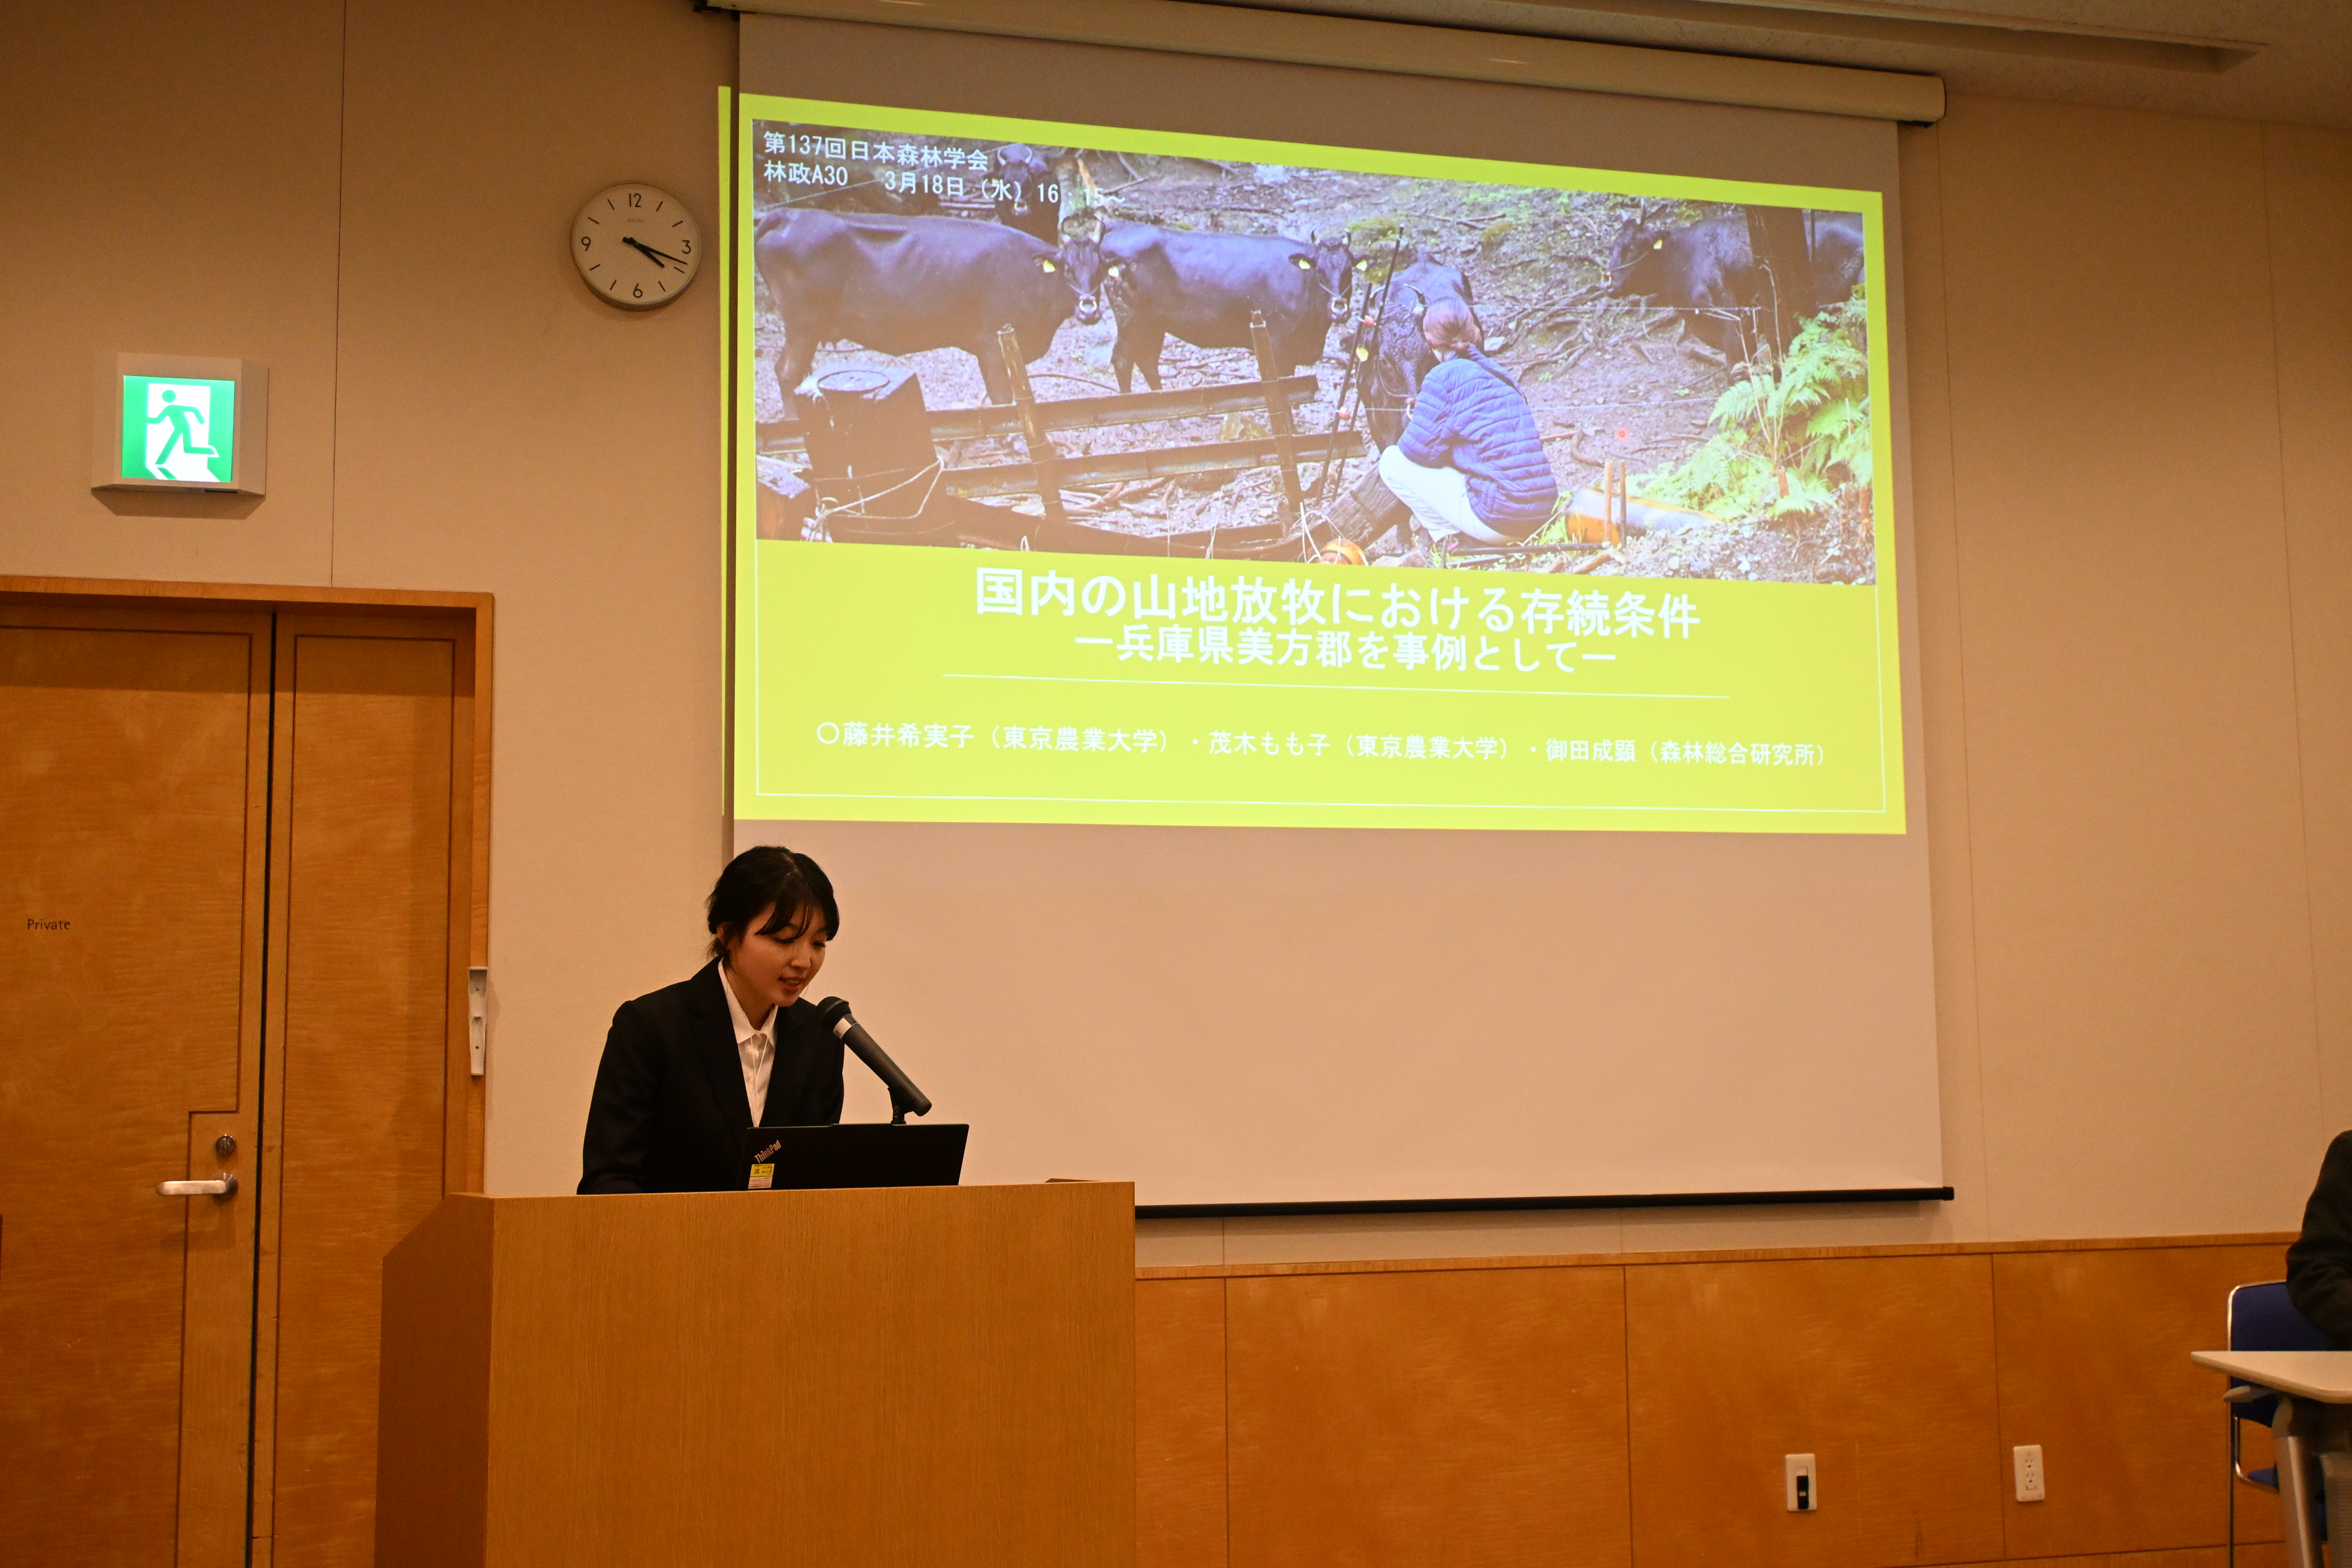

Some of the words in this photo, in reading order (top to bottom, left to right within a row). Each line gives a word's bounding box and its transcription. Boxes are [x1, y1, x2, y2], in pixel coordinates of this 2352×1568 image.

[764, 131, 988, 171] 第137回日本森林学会
[764, 161, 848, 186] 林政A30
[629, 193, 642, 208] 12
[581, 236, 591, 251] 9
[681, 240, 691, 254] 3
[633, 283, 643, 298] 6
[977, 567, 1700, 639] 国内の山地放牧における存続条件
[27, 919, 70, 930] Private
[754, 1139, 781, 1164] ThinkPad
